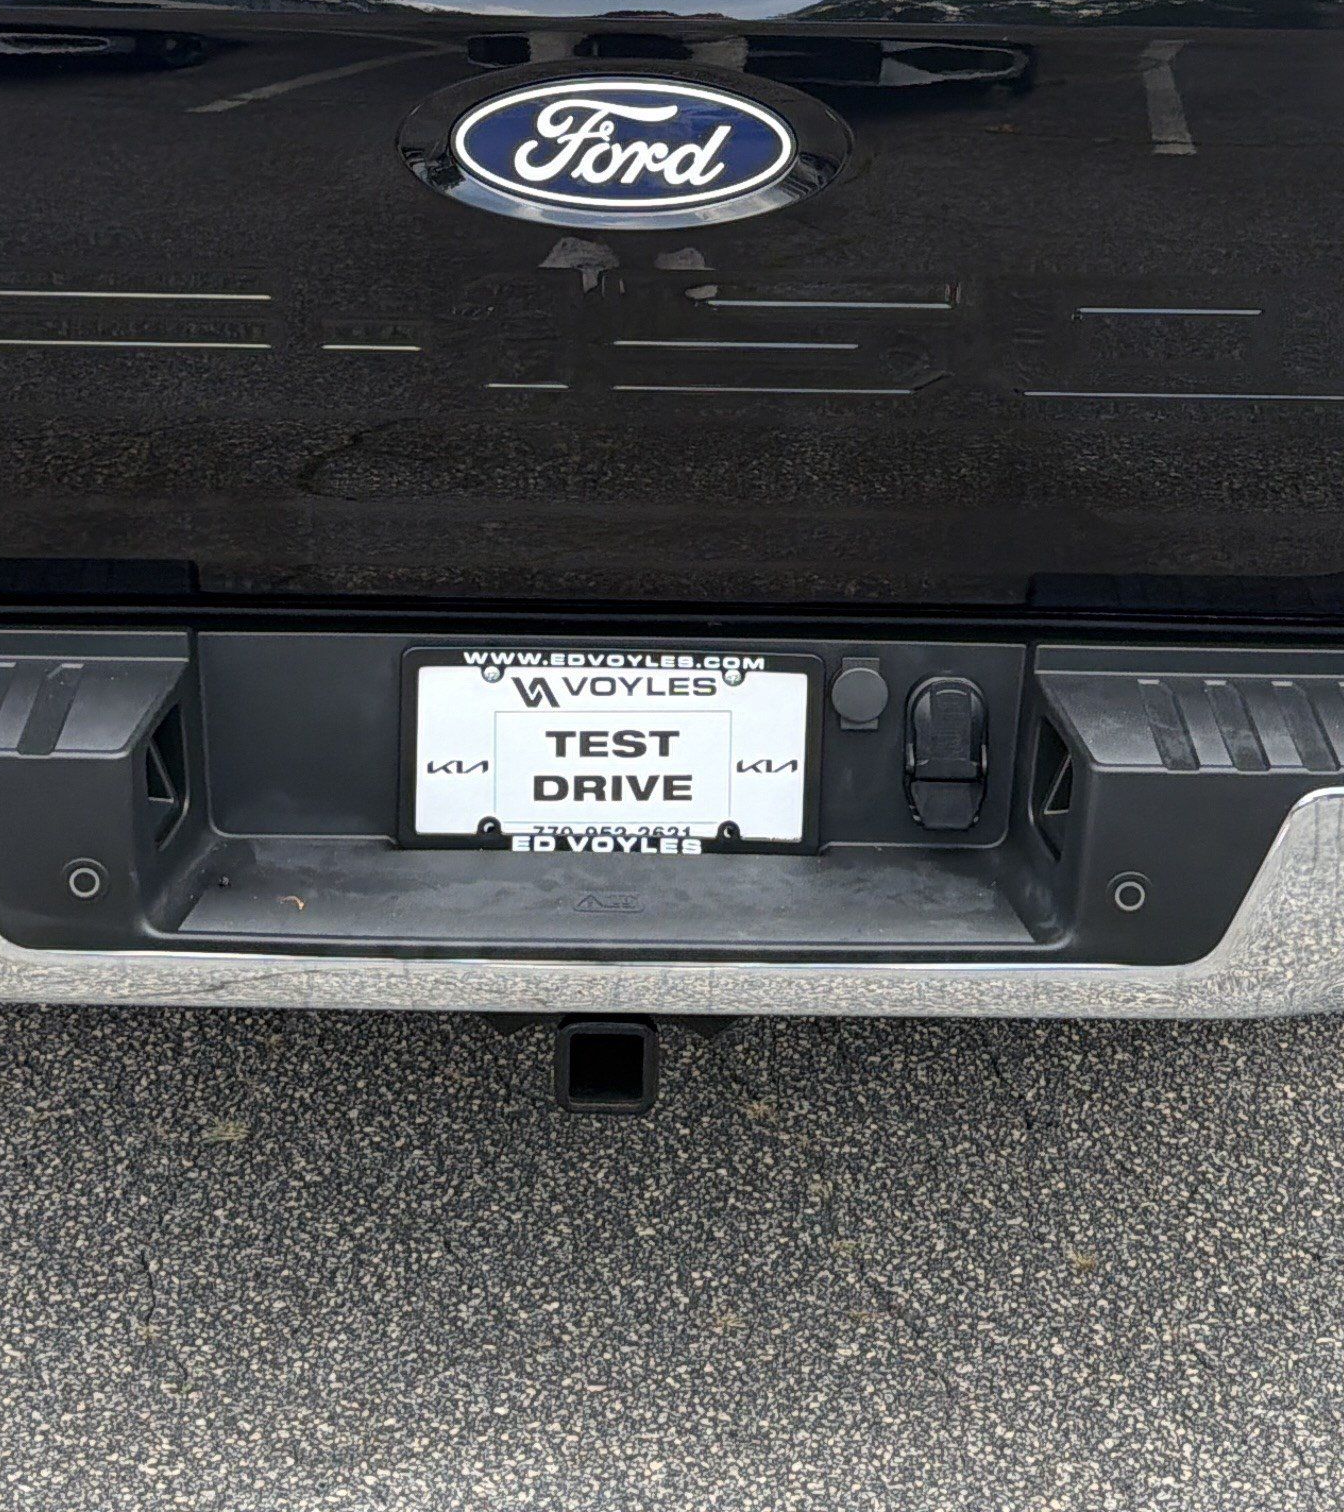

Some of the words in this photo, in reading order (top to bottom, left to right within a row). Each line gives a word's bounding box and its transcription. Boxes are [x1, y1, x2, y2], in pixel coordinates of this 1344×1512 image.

[514, 98, 732, 186] Ford
[463, 651, 766, 671] WWW.EDVOYLES.COM
[562, 675, 718, 697] VOYLES
[545, 729, 680, 758] TEST
[533, 774, 693, 802] DRIVE
[511, 835, 556, 853] ED
[568, 835, 702, 855] VOYLES
